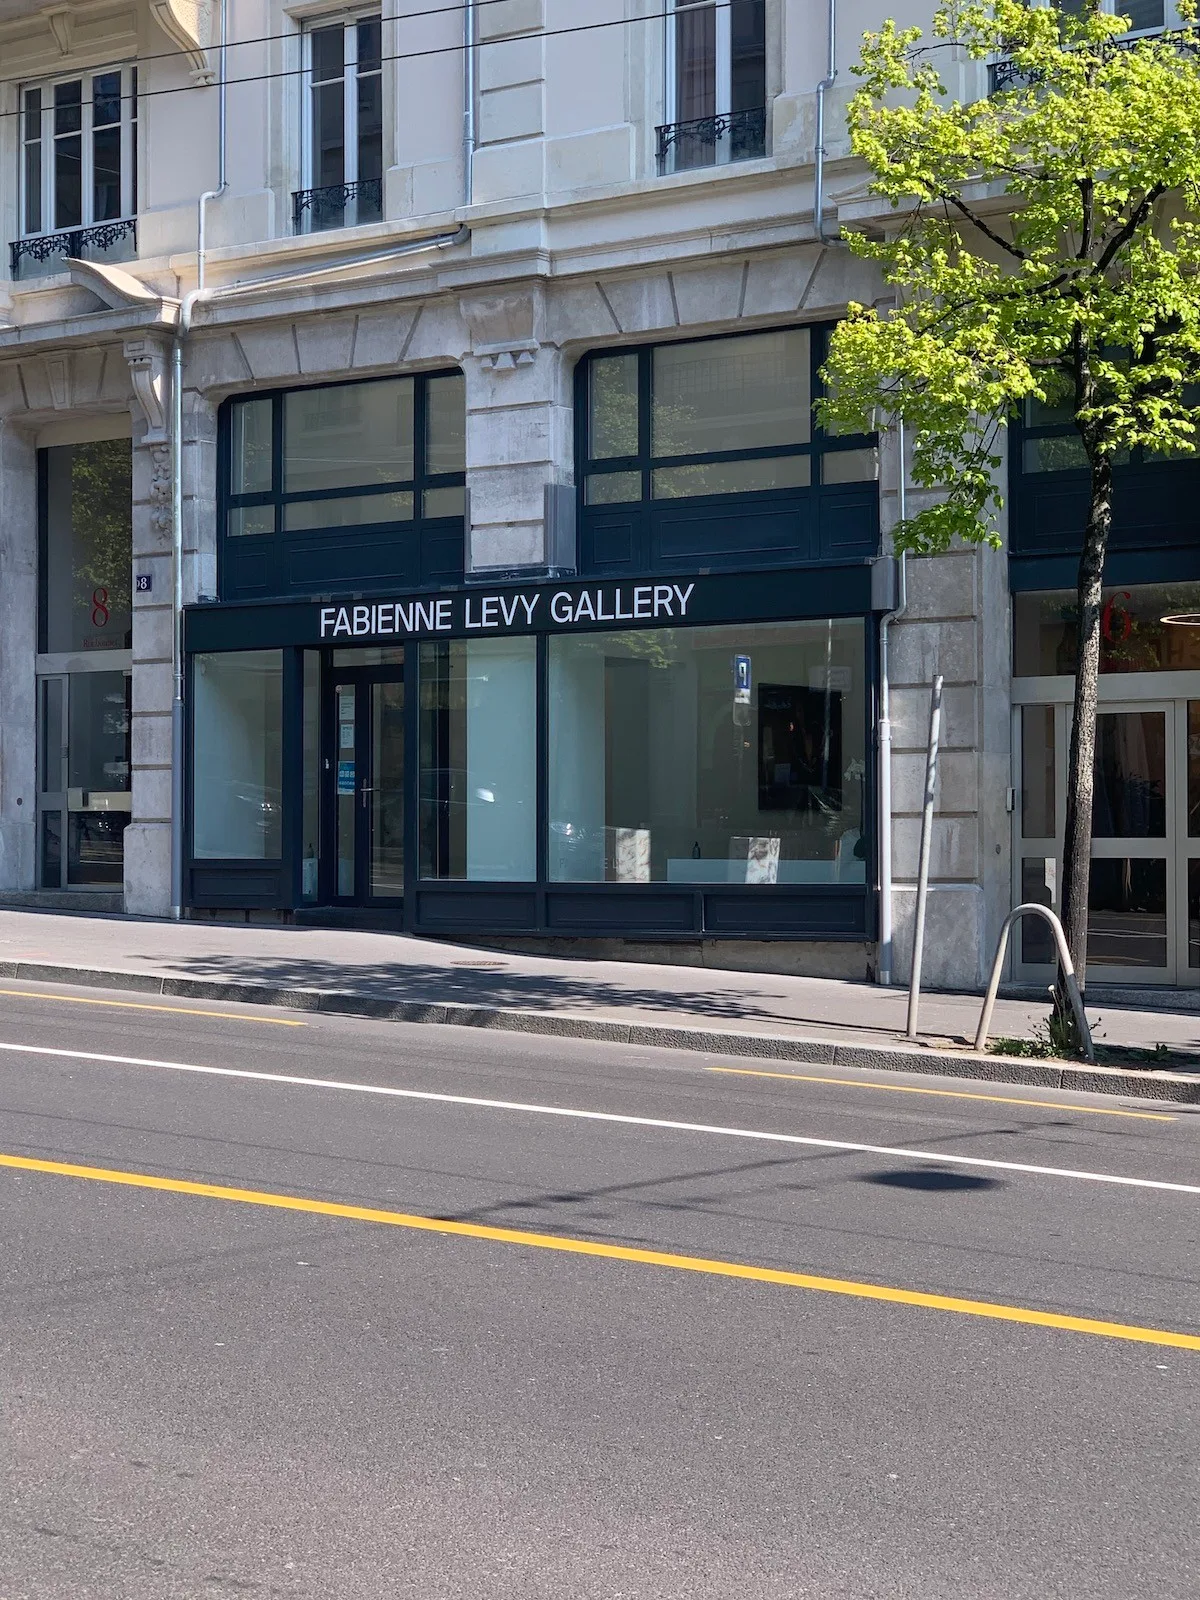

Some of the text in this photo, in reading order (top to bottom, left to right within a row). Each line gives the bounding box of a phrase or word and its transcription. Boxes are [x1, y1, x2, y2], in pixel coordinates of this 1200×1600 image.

[92, 588, 109, 627] 8
[321, 584, 694, 637] FABIENNE LEVY GALLERY
[1103, 591, 1131, 643] 6
